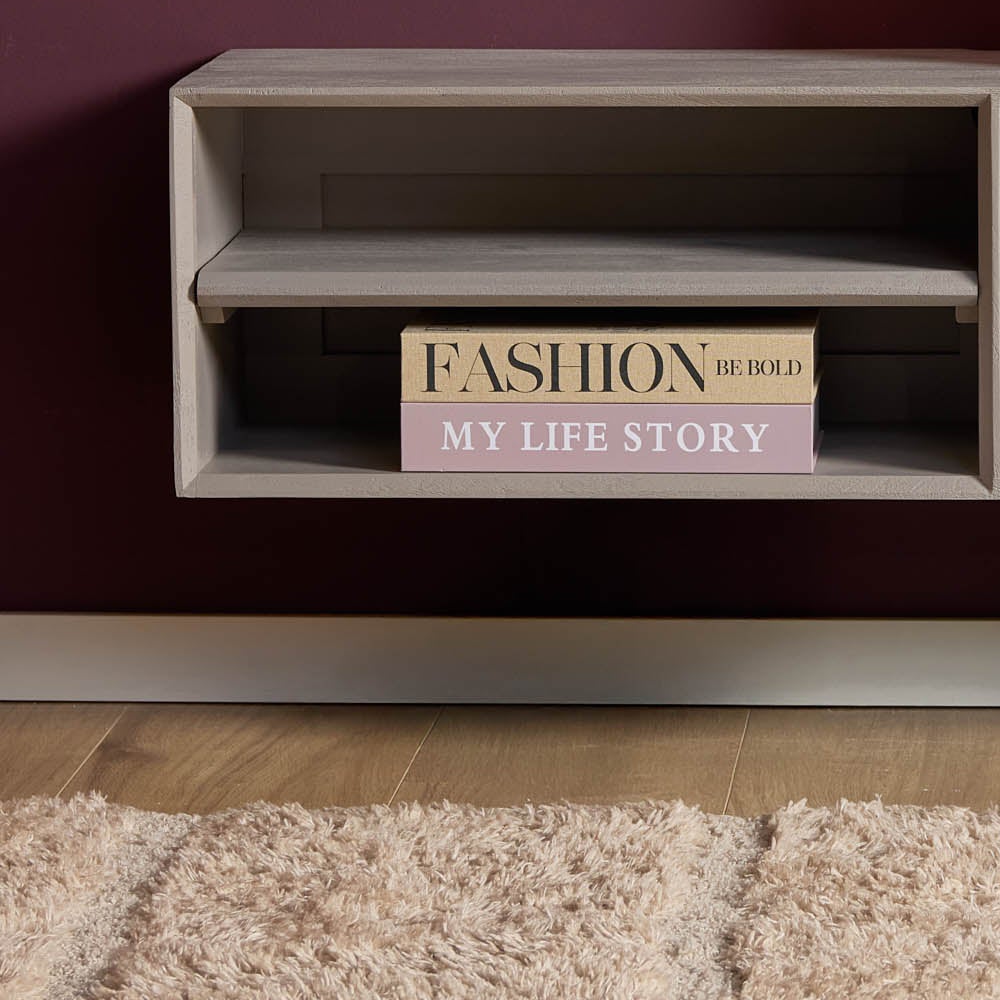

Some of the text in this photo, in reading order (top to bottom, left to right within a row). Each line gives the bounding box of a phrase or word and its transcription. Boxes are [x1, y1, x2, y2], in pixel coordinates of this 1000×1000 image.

[421, 342, 802, 394] FASHION BE BOLD
[440, 421, 770, 453] MY LIFE STORY
